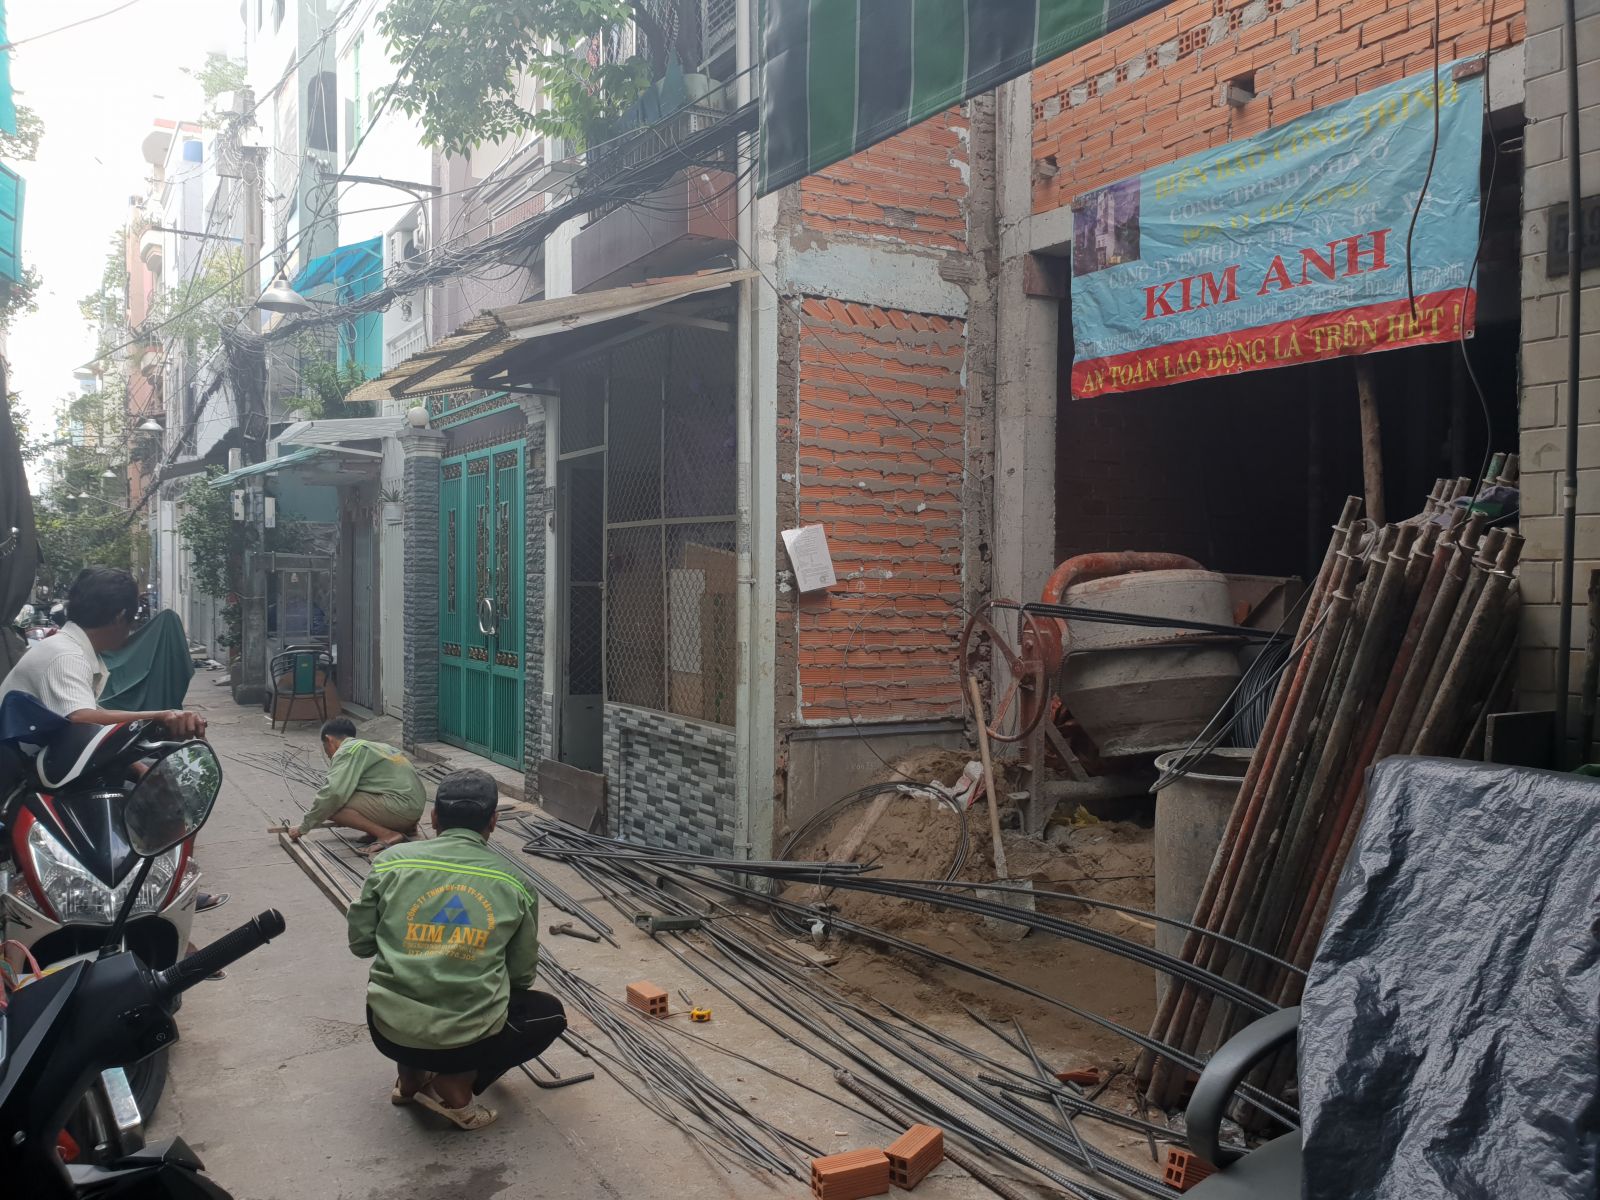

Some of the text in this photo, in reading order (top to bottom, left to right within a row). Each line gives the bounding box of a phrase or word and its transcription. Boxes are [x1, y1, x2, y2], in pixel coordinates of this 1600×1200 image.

[1170, 191, 1225, 223] CÔNG
[1141, 228, 1392, 321] KIM ANH
[1081, 368, 1105, 393] AN
[1108, 357, 1160, 389] TOÀN
[1163, 350, 1202, 378] LAO
[1273, 325, 1304, 360] LÀ
[1308, 315, 1378, 352] TRÊN
[1387, 297, 1445, 342] HẾT
[405, 922, 445, 943] KIM
[447, 926, 490, 948] ANH
